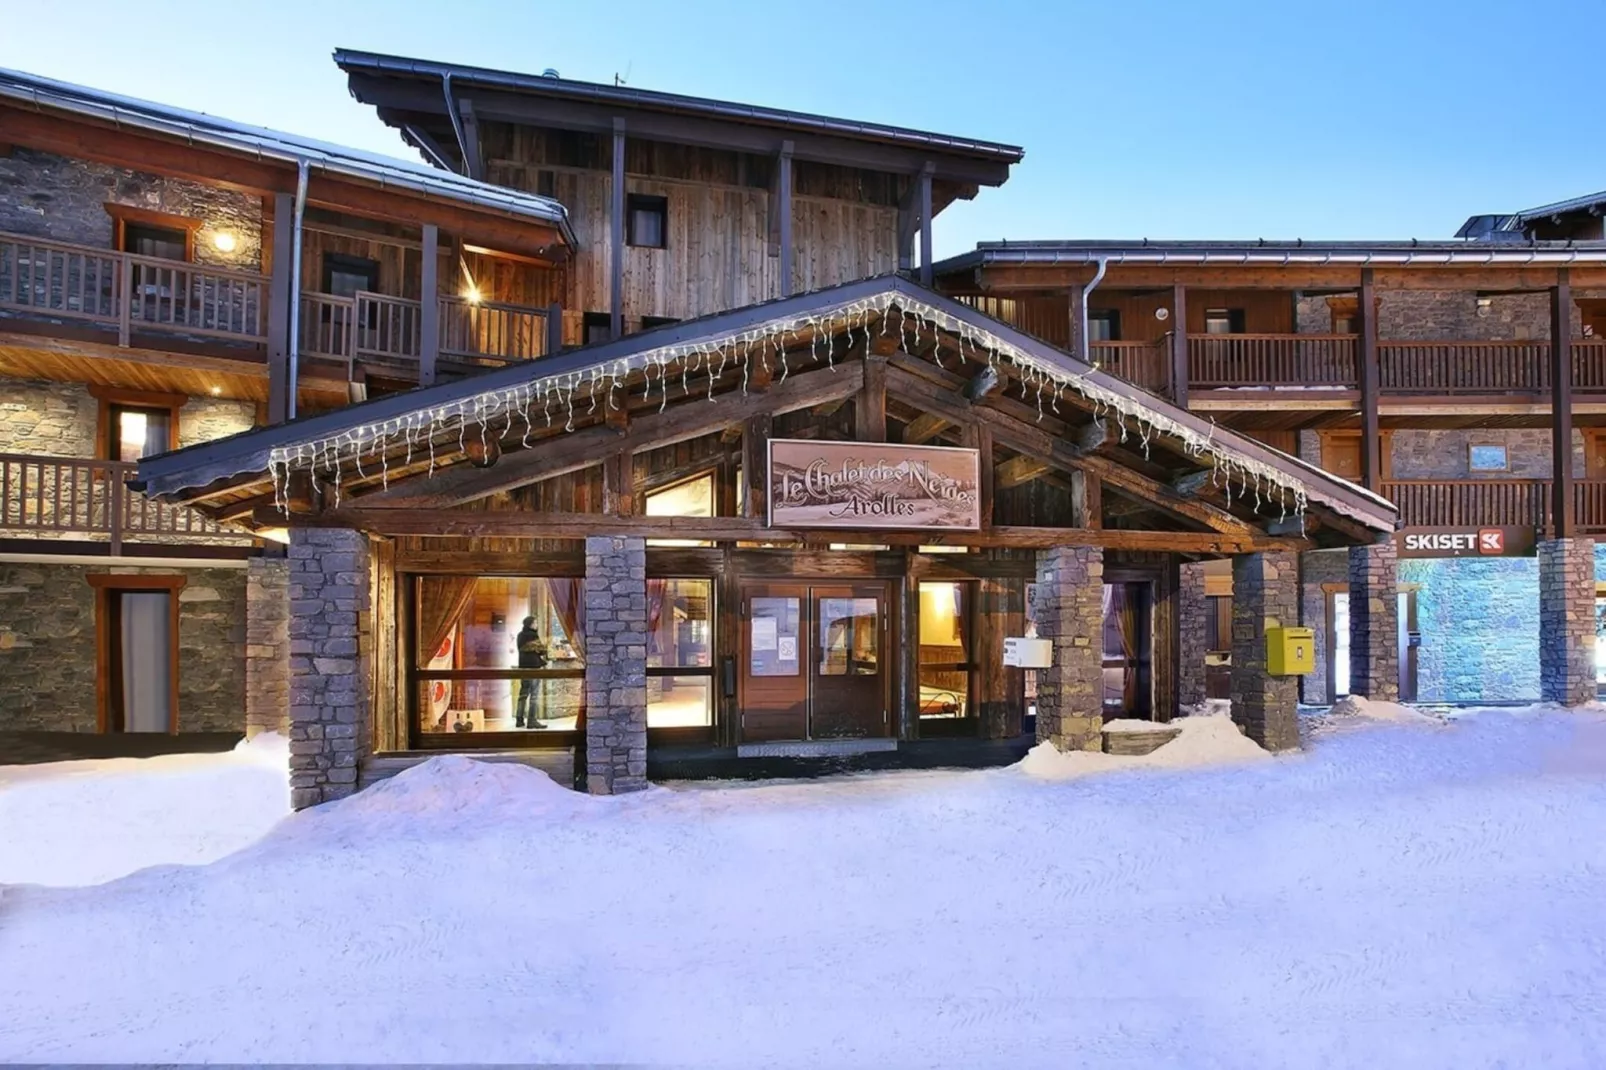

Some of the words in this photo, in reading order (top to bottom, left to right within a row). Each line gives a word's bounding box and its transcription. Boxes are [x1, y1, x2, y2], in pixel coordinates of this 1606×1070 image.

[777, 470, 809, 507] Le
[869, 459, 904, 483] des
[908, 459, 976, 510] Neiges
[829, 495, 914, 516] Arolles
[1405, 534, 1478, 550] SKISET
